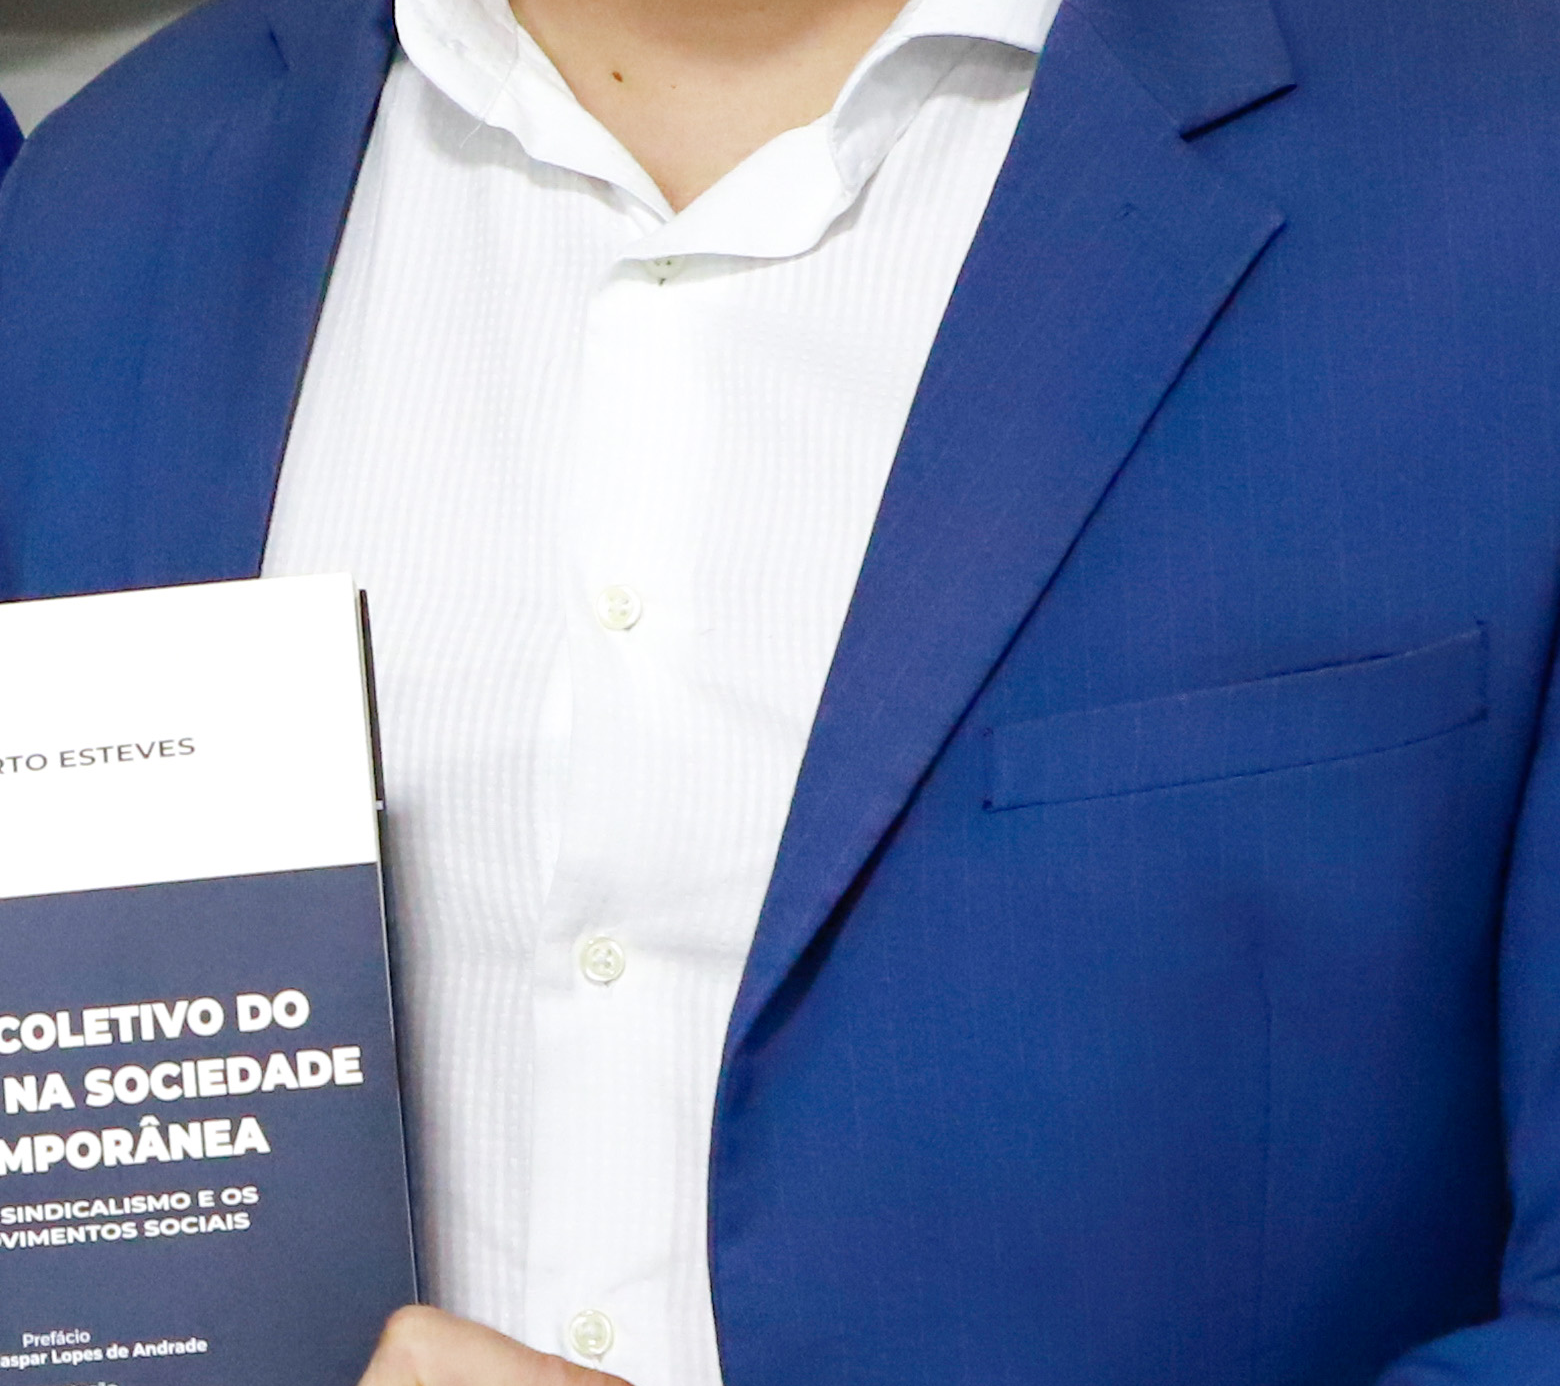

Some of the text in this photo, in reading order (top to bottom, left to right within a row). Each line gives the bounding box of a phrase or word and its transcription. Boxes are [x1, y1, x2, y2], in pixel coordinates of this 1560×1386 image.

[59, 737, 196, 768] ESTEVES
[236, 988, 310, 1033] DO
[3, 1073, 76, 1114] NA
[84, 1045, 364, 1108] SOCIEDADE
[0, 1191, 192, 1224] SINDICALISMO
[198, 1190, 215, 1208] E
[221, 1186, 259, 1205] OS
[144, 1212, 250, 1237] SOCIAIS
[22, 1329, 91, 1348] Prefácio
[51, 1348, 103, 1366] Lopes
[106, 1344, 129, 1359] de
[132, 1337, 208, 1358] Andrade
